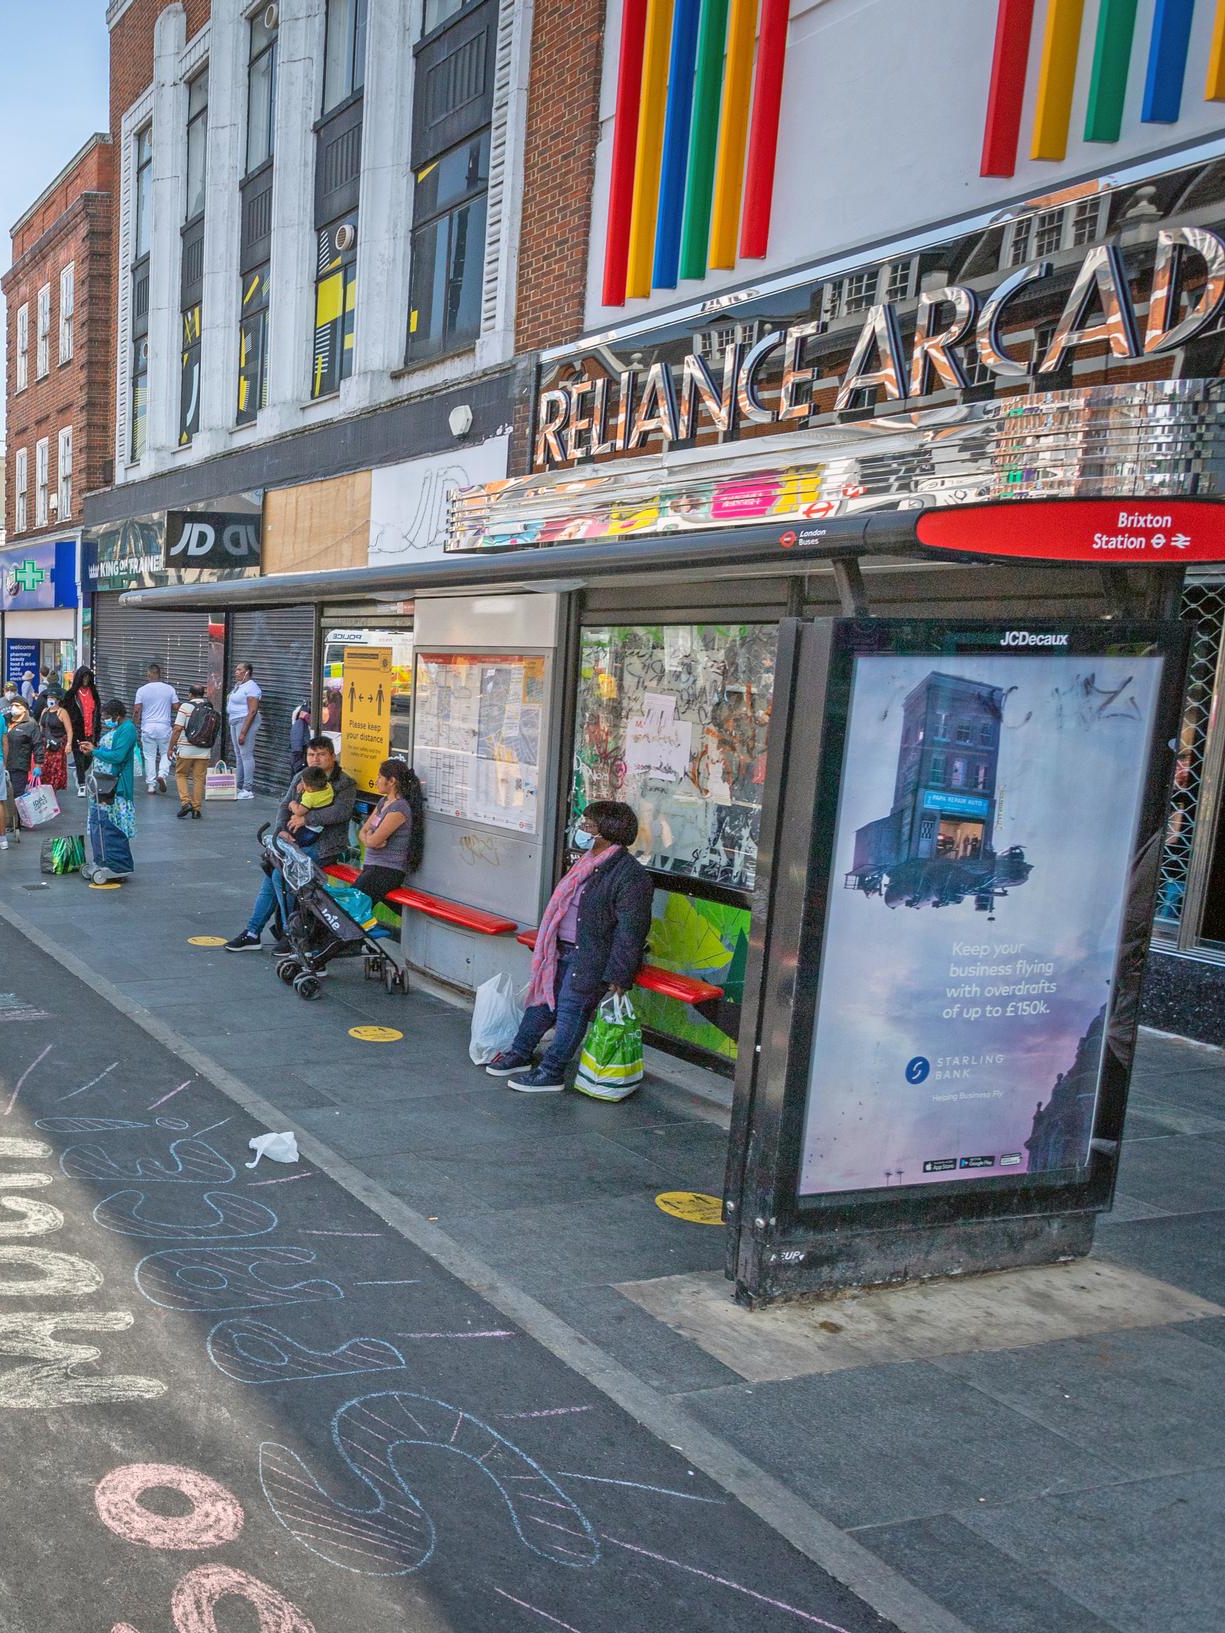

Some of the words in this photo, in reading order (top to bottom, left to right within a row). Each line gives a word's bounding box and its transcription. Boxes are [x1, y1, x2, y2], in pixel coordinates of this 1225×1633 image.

[533, 321, 826, 466] RELIANCE
[833, 226, 1225, 412] ARCAD
[1117, 512, 1172, 528] Brixton
[170, 523, 215, 556] JD
[799, 528, 827, 537] London
[798, 537, 819, 546] Buses
[1092, 533, 1146, 549] Station
[100, 560, 119, 577] KING
[1000, 631, 1069, 647] JCDecaux
[349, 720, 367, 730] Please
[367, 722, 382, 734] keep
[346, 732, 359, 742] your
[359, 733, 384, 744] distance
[952, 942, 990, 958] Keep
[992, 942, 1025, 957] your
[949, 963, 1012, 977] business
[1015, 960, 1055, 979] flying
[945, 984, 980, 998] with
[984, 980, 1057, 997] overdrafts
[942, 1003, 961, 1019] of
[962, 1006, 982, 1020] up
[986, 1004, 1002, 1016] to
[1005, 1000, 1051, 1017] £150k.
[936, 1054, 1006, 1068] STARLING
[935, 1069, 970, 1080] BANK
[932, 1092, 958, 1102] Helping
